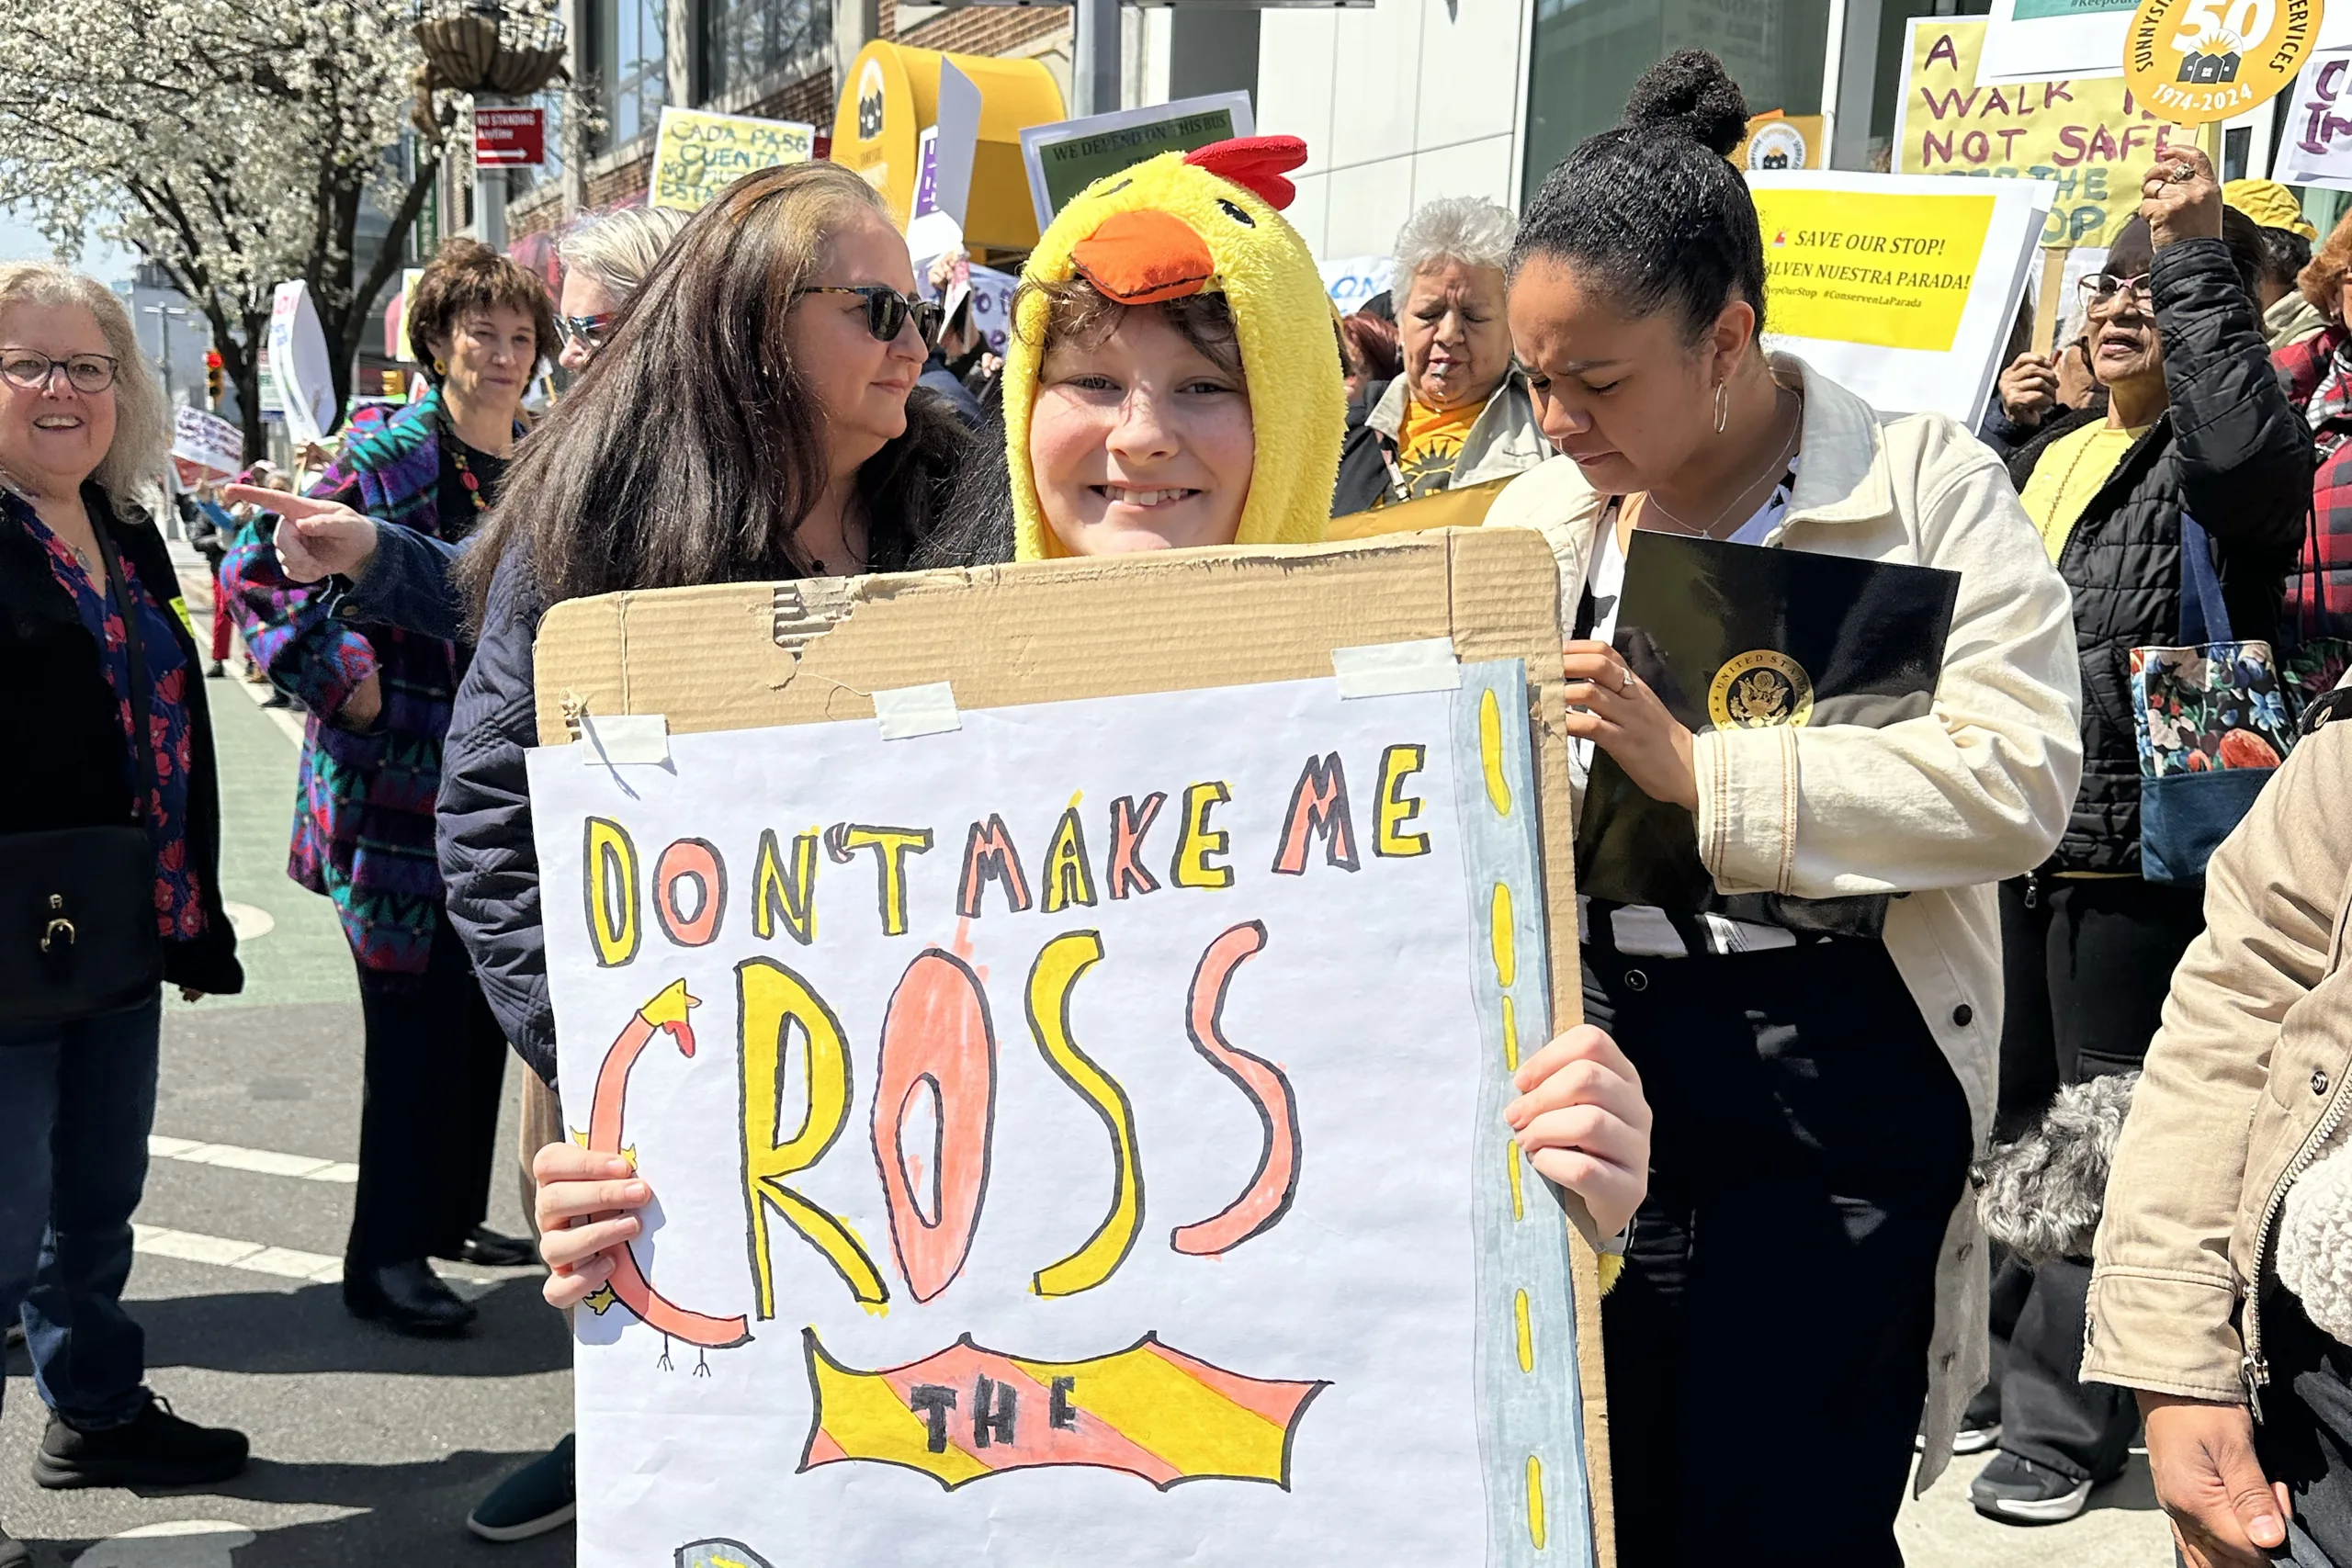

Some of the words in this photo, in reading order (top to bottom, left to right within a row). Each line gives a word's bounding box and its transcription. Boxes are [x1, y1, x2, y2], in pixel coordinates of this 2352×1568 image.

[1924, 34, 1958, 72] A
[2135, 0, 2174, 73] SUNNYSI
[2268, 0, 2308, 73] ERVICES
[1920, 80, 2074, 119] WALK
[2152, 83, 2252, 111] 1974-2024
[477, 113, 491, 127] NO
[491, 112, 537, 126] STANDING
[478, 129, 514, 142] Anytime
[671, 120, 736, 142] CADA
[751, 128, 810, 153] PASO
[1053, 143, 1078, 162] WE
[1081, 130, 1143, 157] DEPEND
[1143, 127, 1167, 145] ON
[1202, 114, 1227, 133] BUS
[1923, 129, 2027, 167] NOT
[662, 160, 687, 180] NO
[680, 143, 780, 169] CUENTA
[661, 180, 715, 202] ESTA
[2041, 206, 2106, 243] OP
[1794, 231, 1843, 249] SAVE
[1845, 234, 1887, 253] OUR
[1889, 237, 1946, 256] STOP!
[1767, 262, 1814, 277] ALVEN
[1815, 264, 1892, 285] NUESTRA
[1896, 272, 1971, 290] PARADA!
[1770, 286, 1818, 300] epOurStop
[1823, 289, 1922, 309] #ConservenLaParada
[1716, 654, 1763, 690] UNITED
[582, 815, 934, 968] DON'T
[956, 782, 1234, 919] MAKE
[1271, 744, 1430, 876] ME
[910, 1374, 1079, 1455] THE
